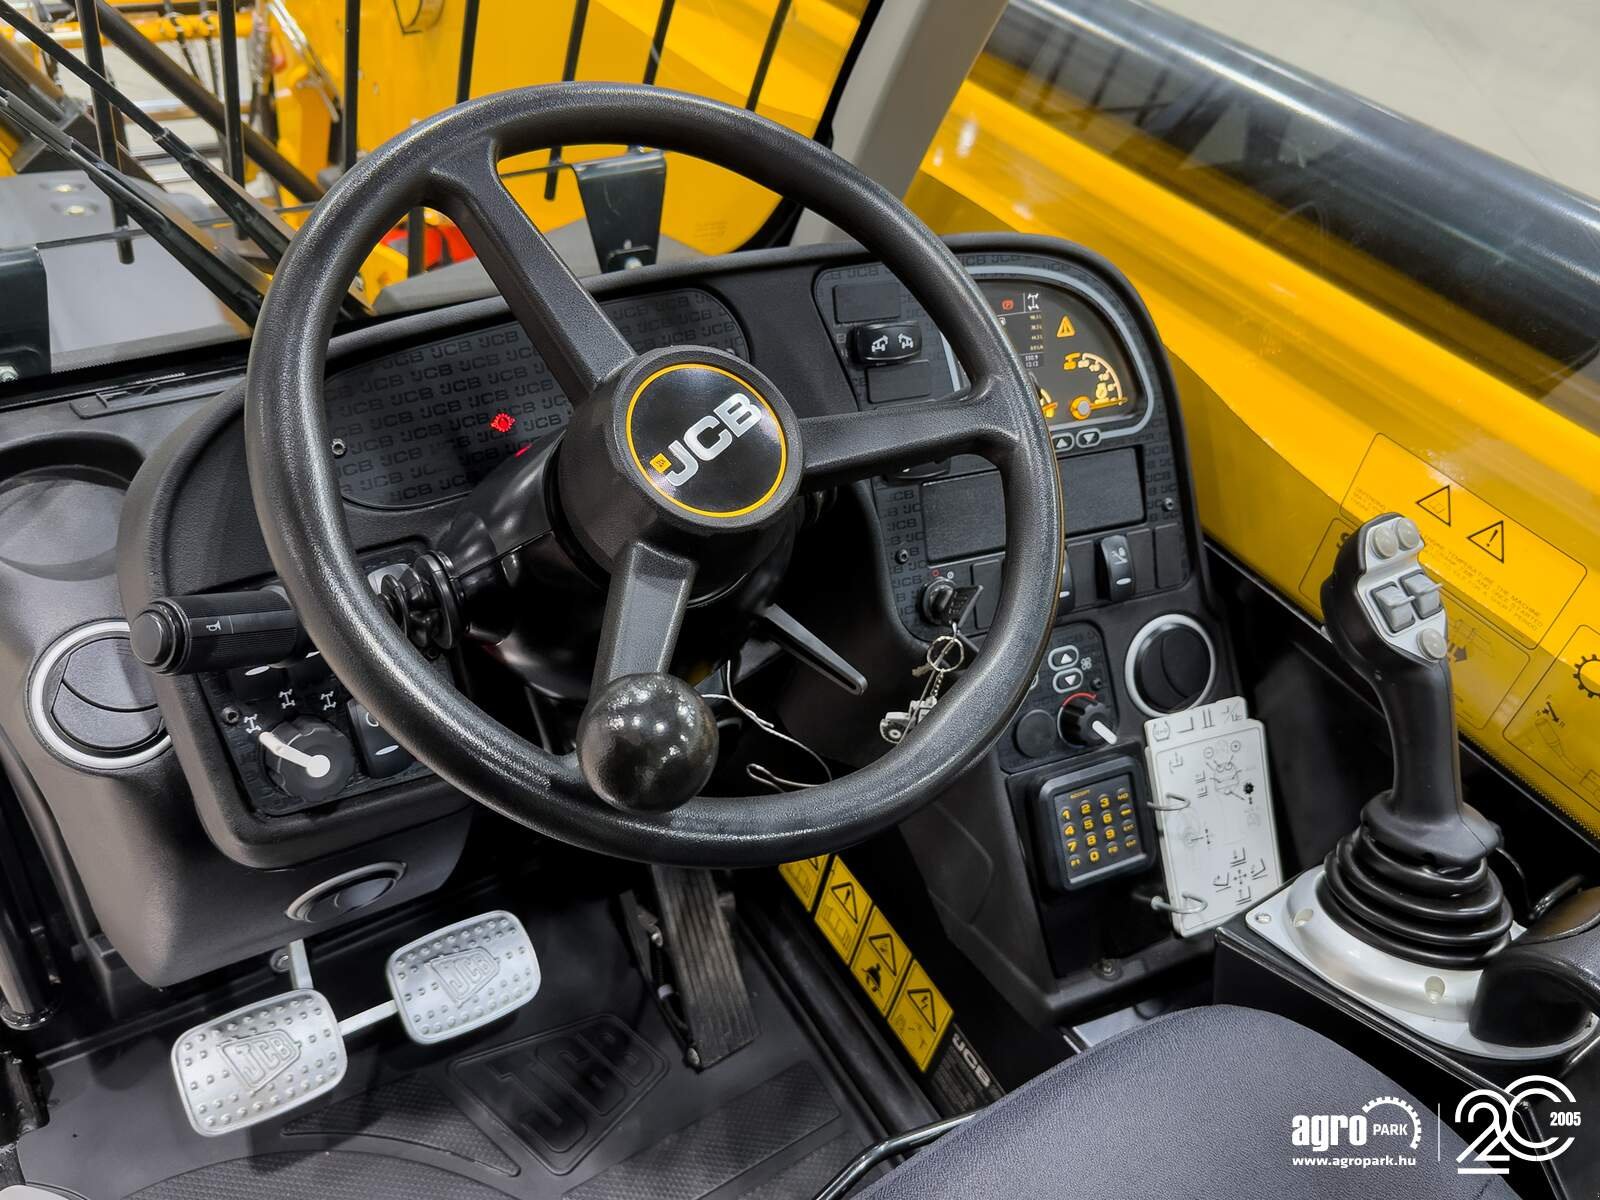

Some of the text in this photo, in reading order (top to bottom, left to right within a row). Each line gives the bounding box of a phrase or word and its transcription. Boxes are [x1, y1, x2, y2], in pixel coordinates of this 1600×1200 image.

[431, 340, 472, 359] JCB
[479, 331, 519, 348] JCB
[410, 364, 453, 382] JCB
[459, 354, 500, 372] JCB
[390, 387, 434, 406] JCB
[440, 376, 481, 396] JCB
[488, 366, 528, 384] JCB
[370, 411, 414, 431] JCB
[420, 400, 462, 419] JCB
[468, 390, 510, 409] JCB
[515, 379, 554, 397] JCB
[380, 447, 423, 467] JCB
[521, 414, 562, 432] JCB
[400, 424, 442, 442] JCB
[650, 393, 761, 486] JCB
[1062, 809, 1070, 820] 1
[1081, 803, 1091, 814] 2
[1100, 797, 1110, 808] 3
[1064, 813, 1113, 836] 4 5 6
[1067, 829, 1116, 853] 7 8 9
[1089, 851, 1100, 863] 0
[440, 955, 492, 999] JCB
[236, 1030, 292, 1081] JCB
[952, 1032, 991, 1088] JCB
